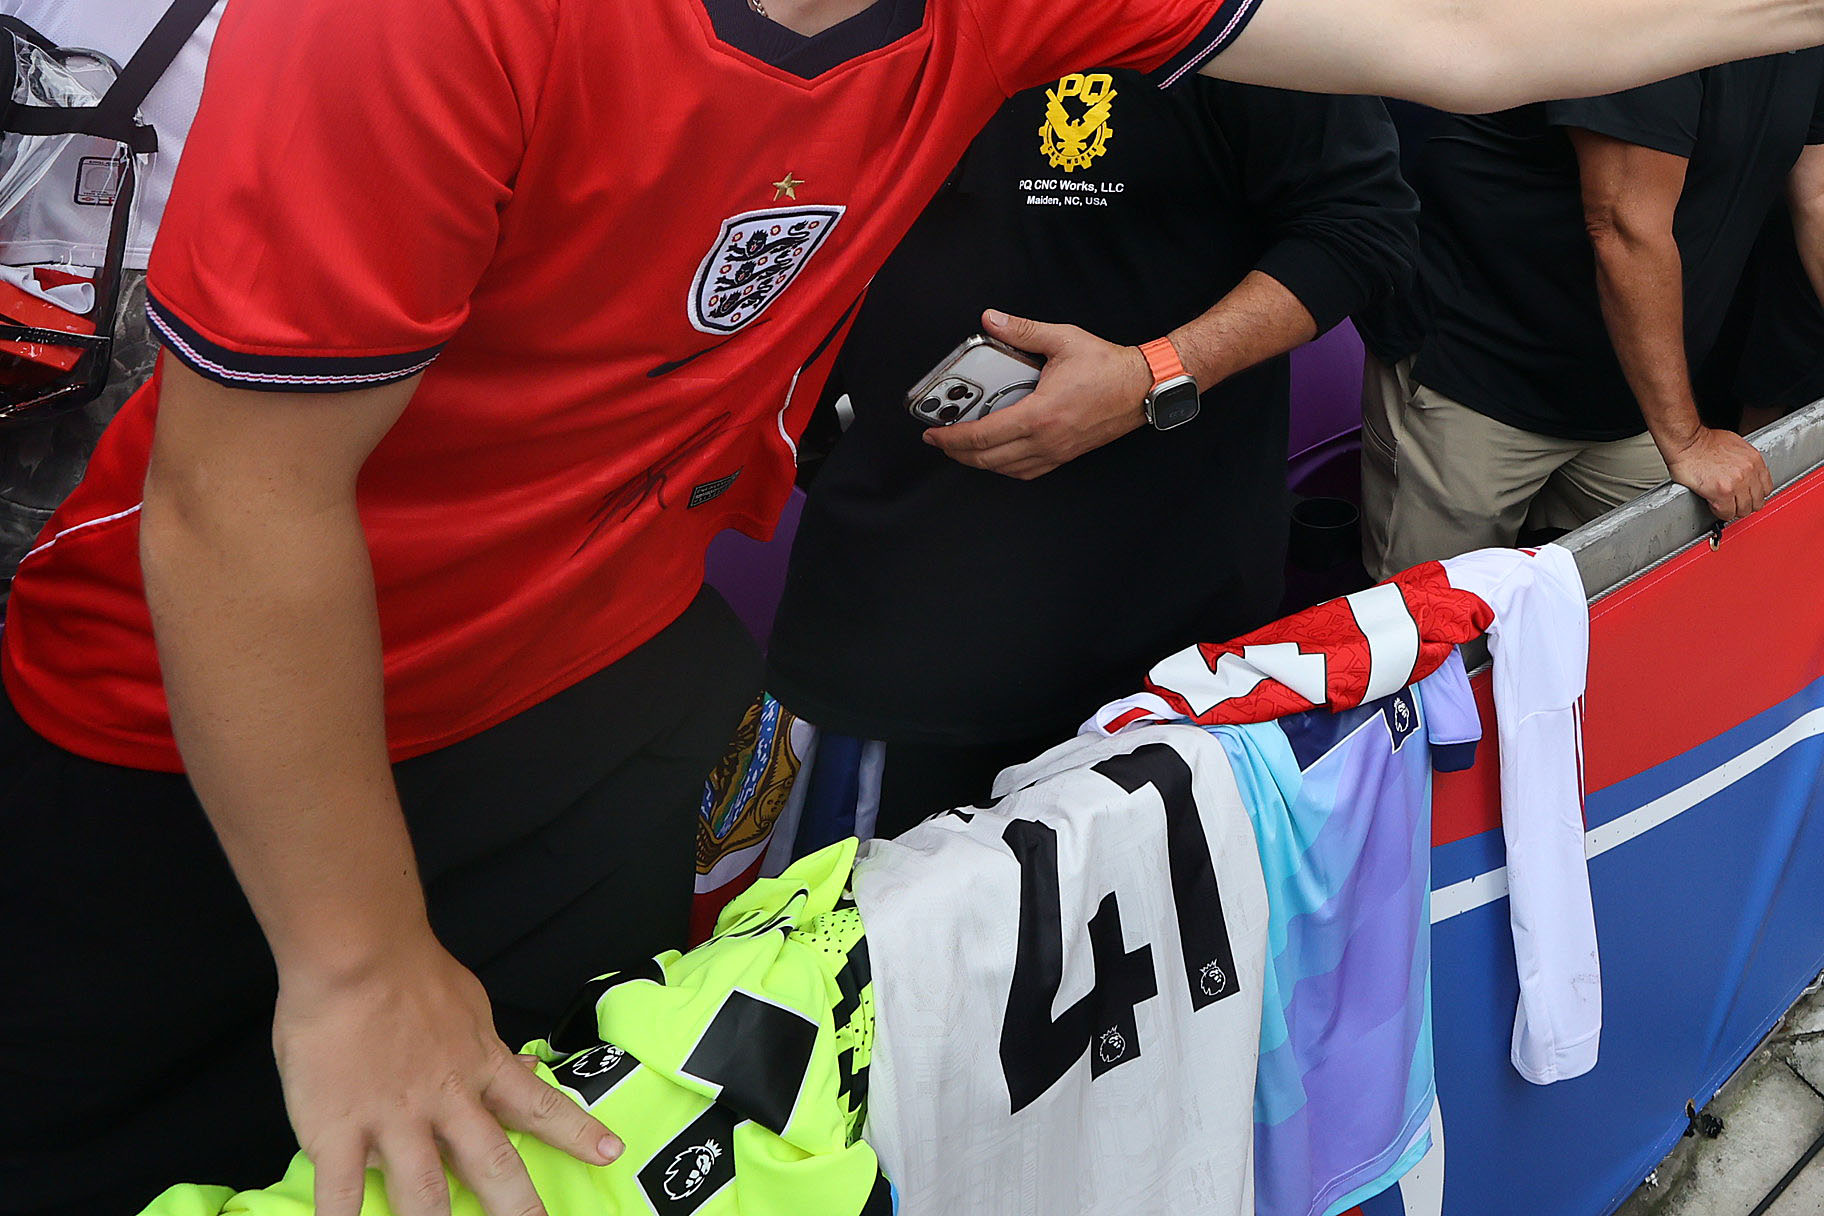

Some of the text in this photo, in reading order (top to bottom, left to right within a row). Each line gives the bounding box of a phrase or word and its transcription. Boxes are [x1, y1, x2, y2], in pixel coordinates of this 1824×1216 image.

[1056, 73, 1114, 107] PQ
[1019, 179, 1125, 194] PQ CNC Works, LLC
[1026, 195, 1108, 206] Maiden, NC, USA
